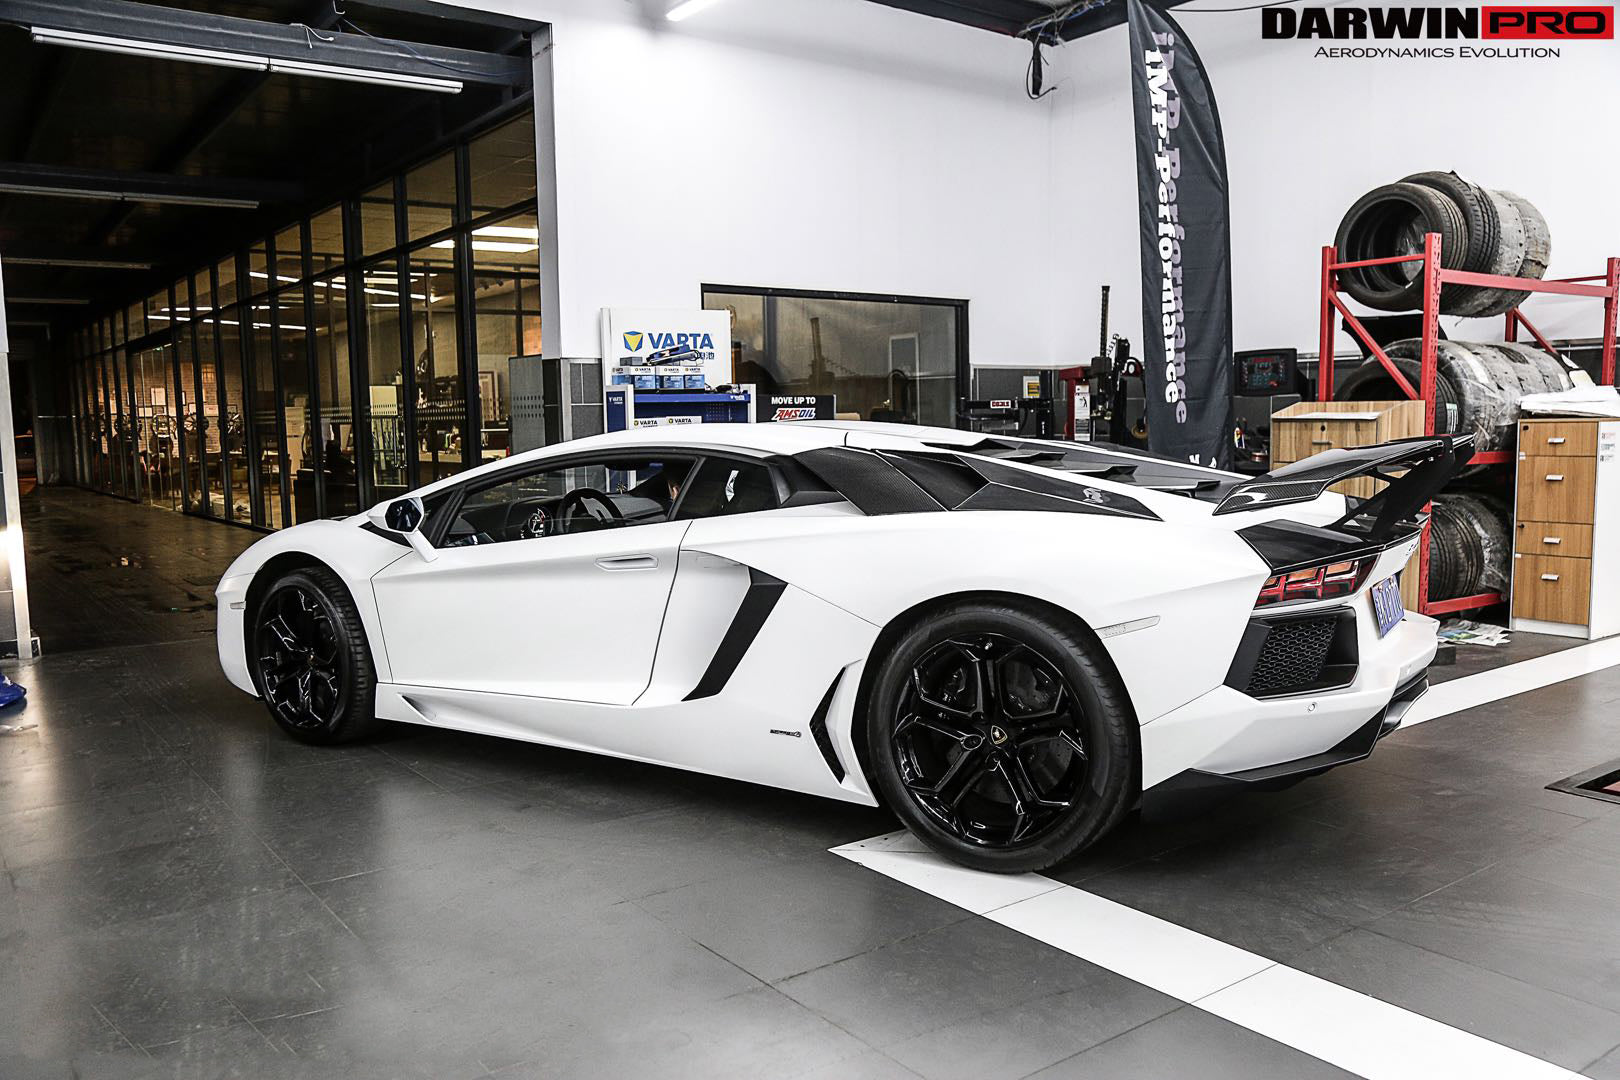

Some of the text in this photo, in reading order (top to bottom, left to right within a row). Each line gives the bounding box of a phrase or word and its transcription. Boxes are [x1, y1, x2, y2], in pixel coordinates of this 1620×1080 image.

[648, 333, 714, 349] VARTA
[771, 396, 816, 405] MOVE UP TO
[771, 408, 816, 422] AMSOIL
